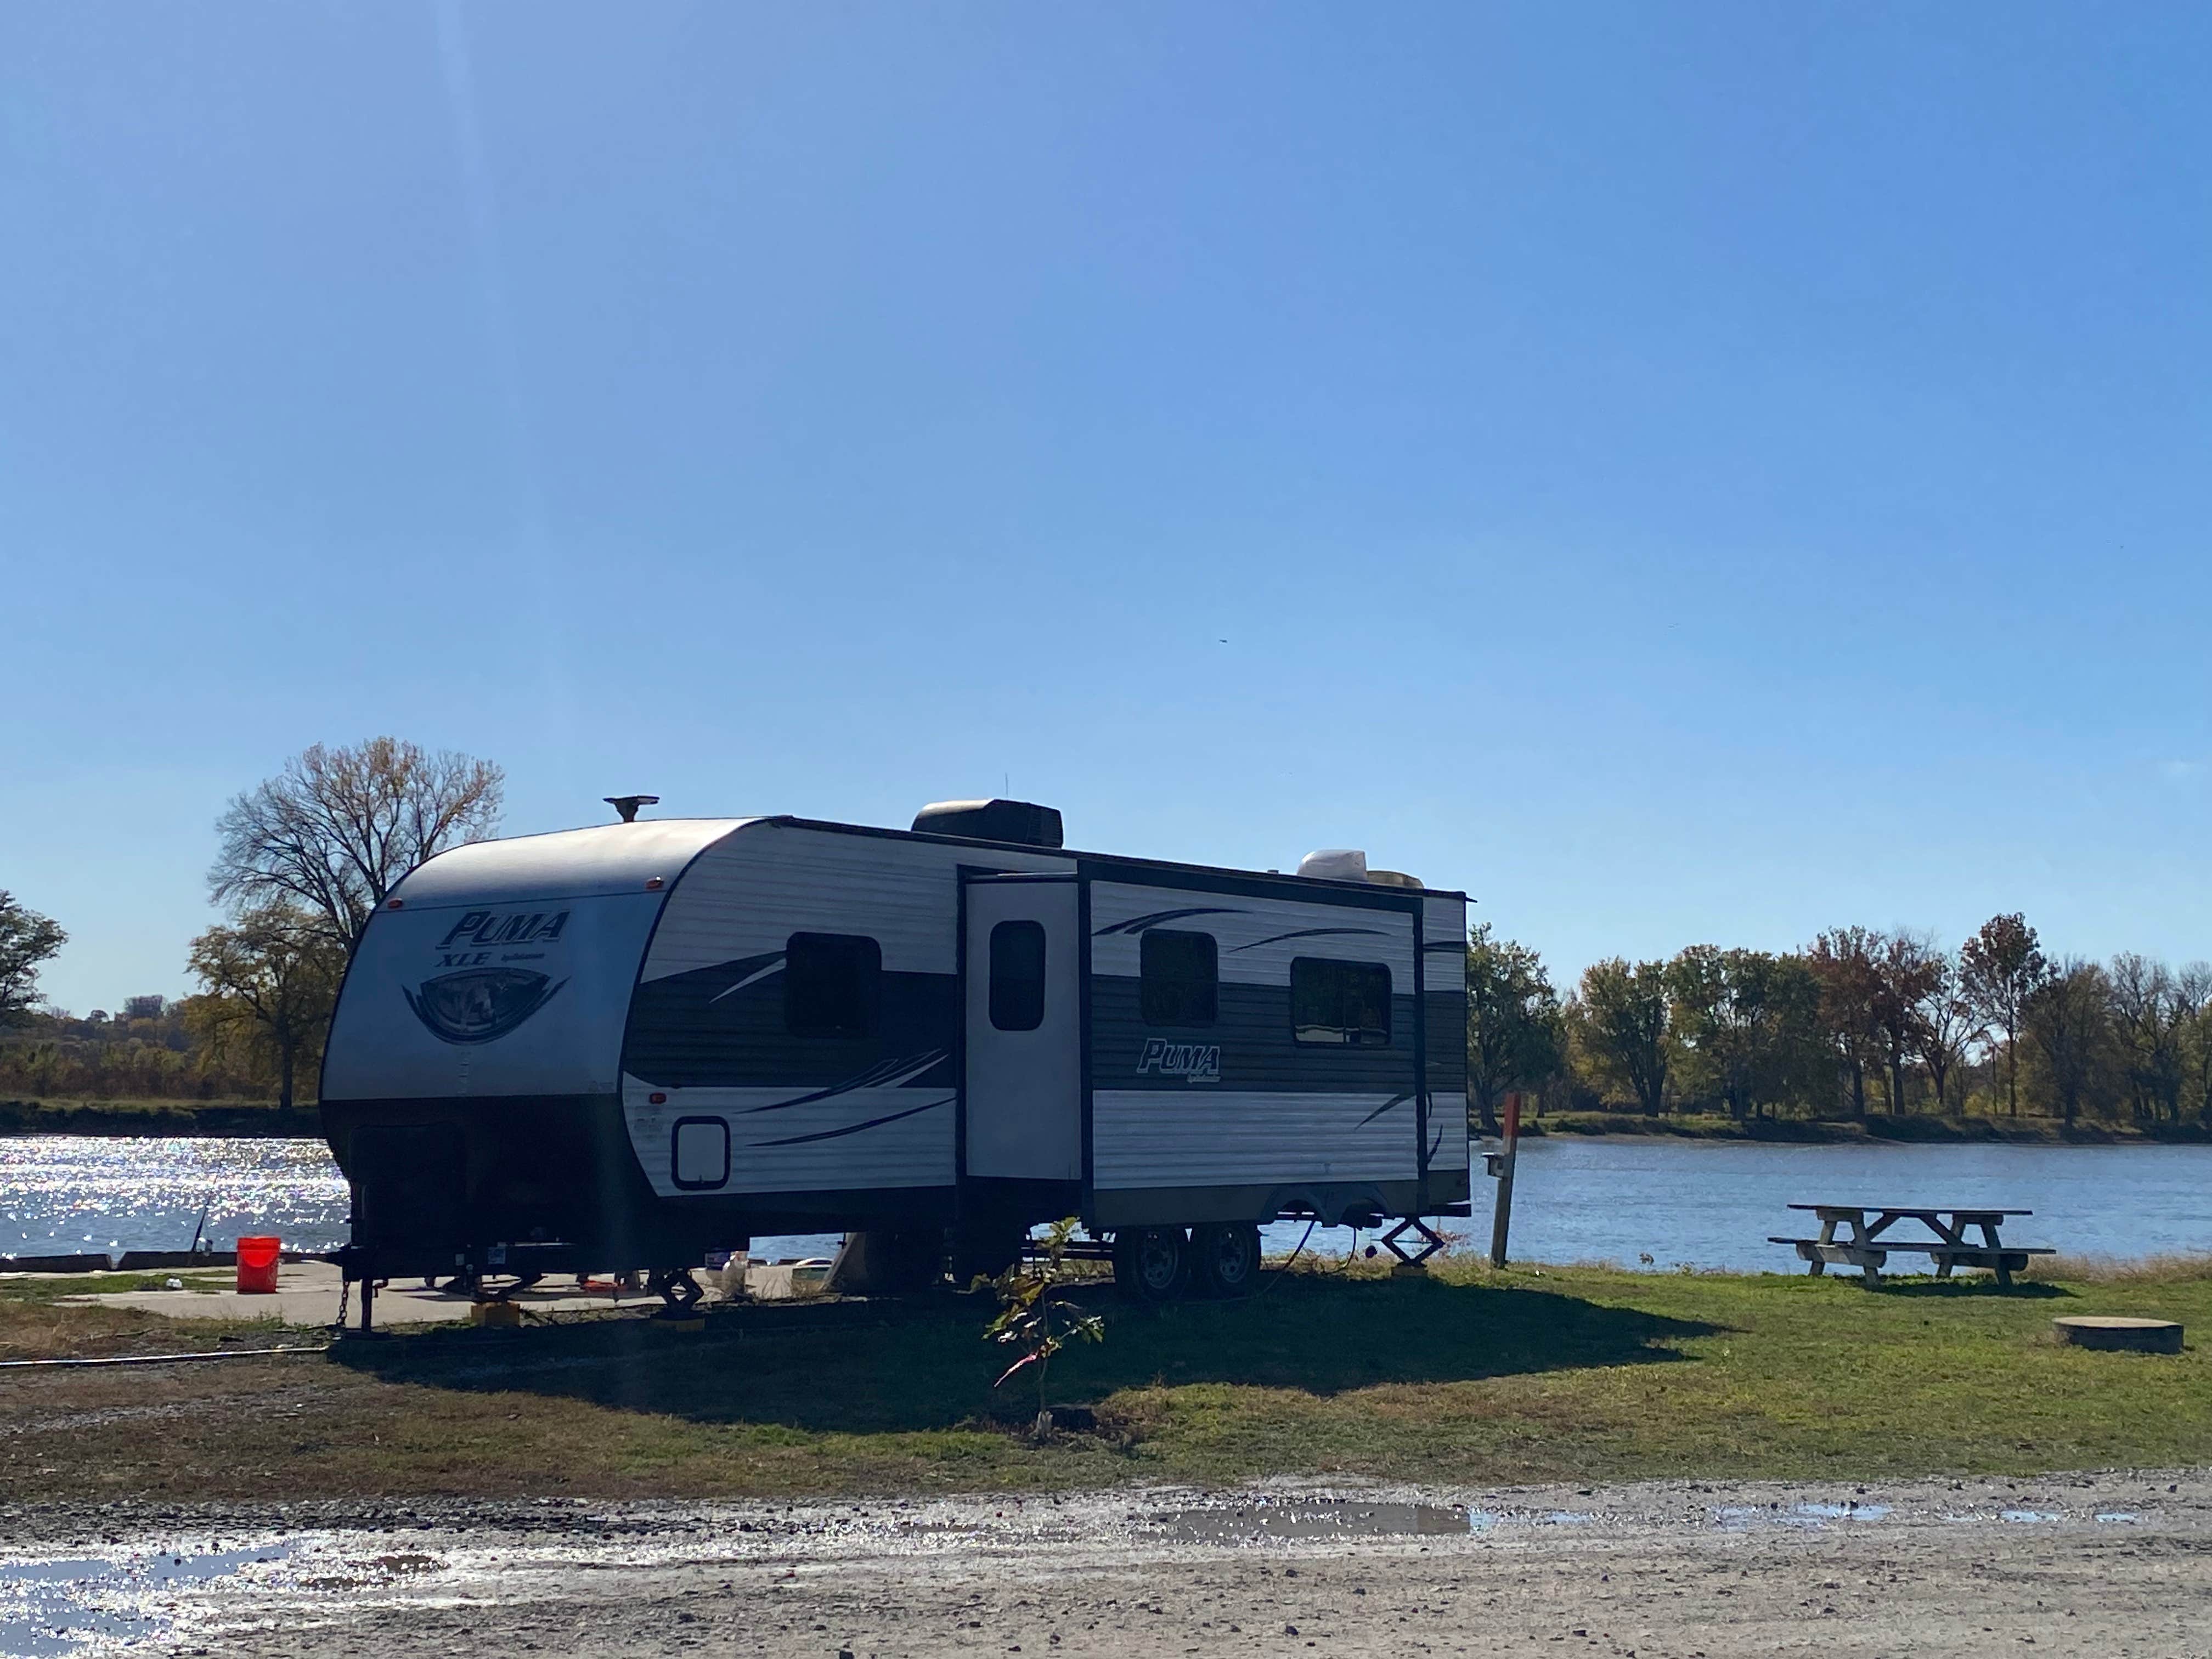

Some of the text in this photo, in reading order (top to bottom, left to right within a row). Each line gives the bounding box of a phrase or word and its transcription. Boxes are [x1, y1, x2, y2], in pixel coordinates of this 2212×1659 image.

[435, 909, 571, 950] PUMA
[434, 952, 492, 967] XLE
[1136, 1037, 1221, 1074] PUMA
